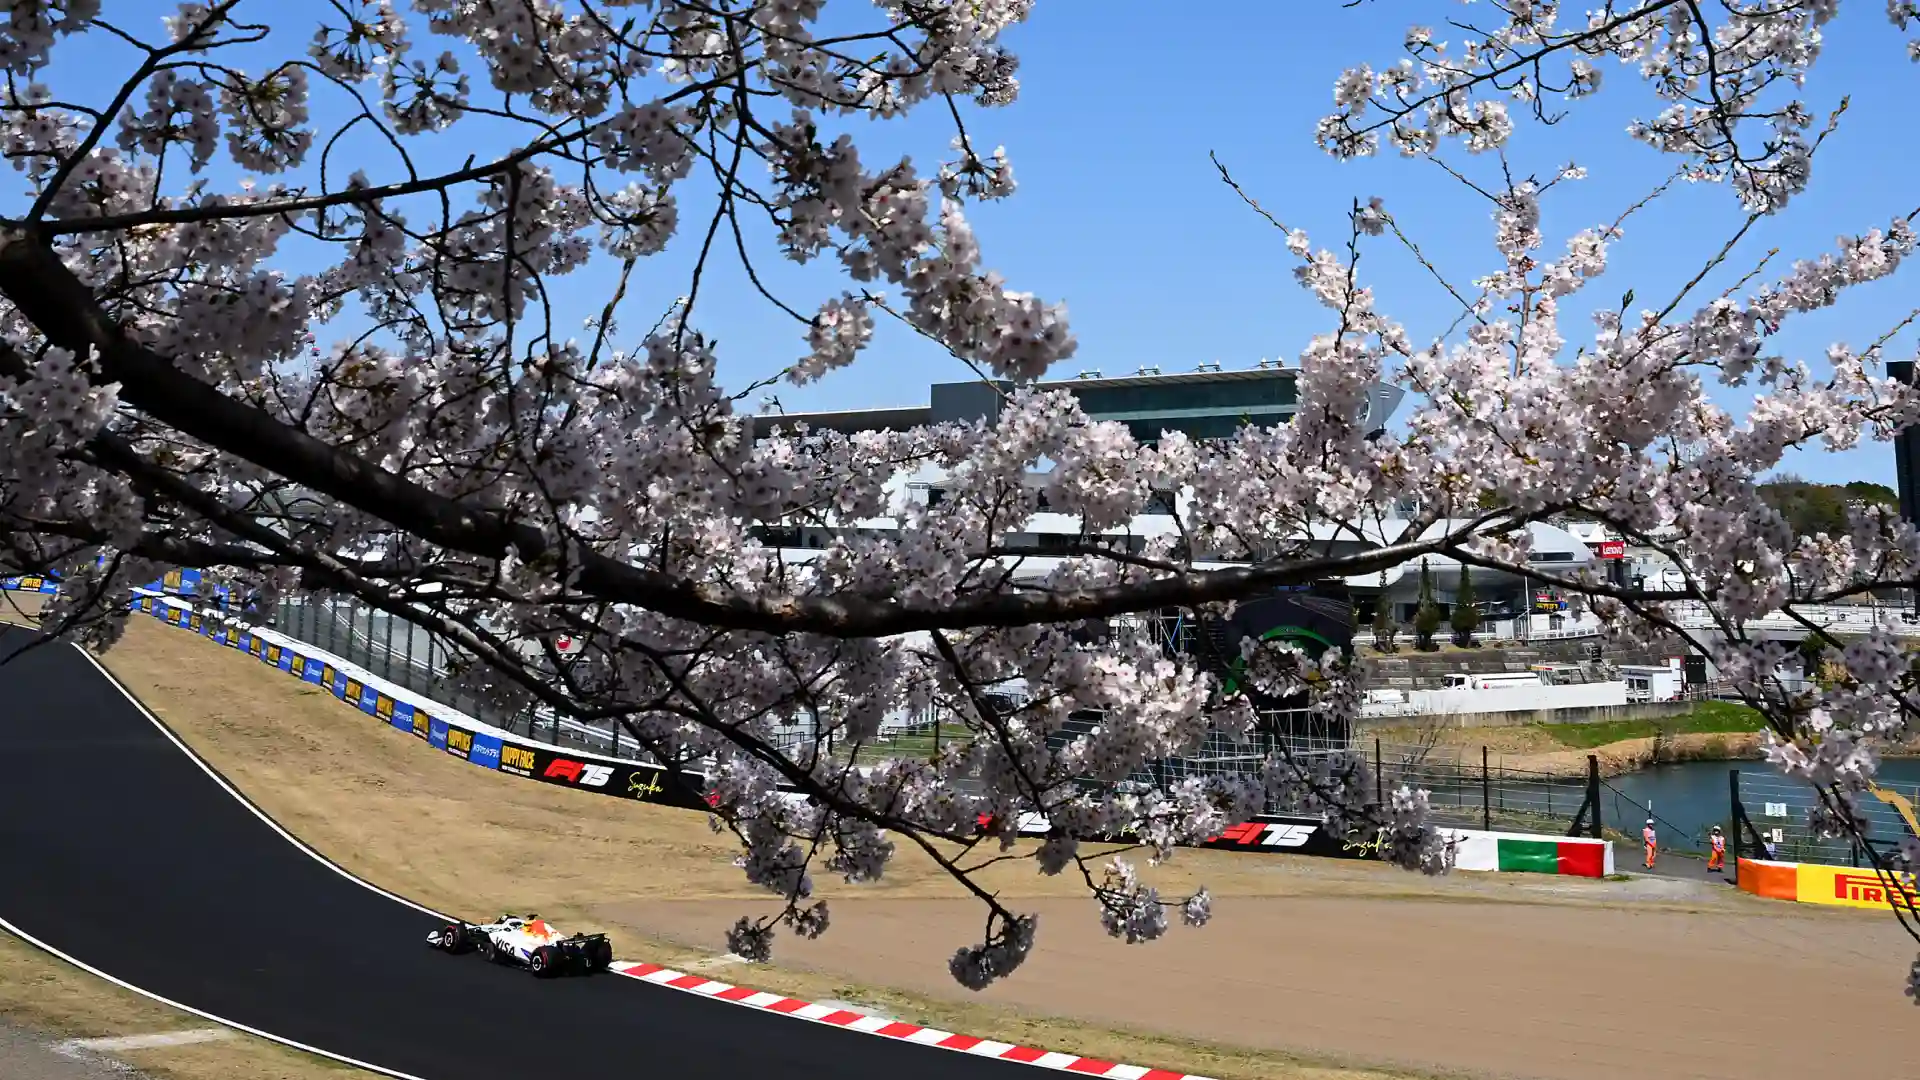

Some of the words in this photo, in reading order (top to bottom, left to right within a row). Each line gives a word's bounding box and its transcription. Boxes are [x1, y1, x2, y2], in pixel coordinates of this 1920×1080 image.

[1603, 544, 1623, 555] Lenovo
[579, 763, 615, 787] 75
[628, 772, 664, 797] Suzuka
[1261, 823, 1318, 847] 75
[495, 936, 515, 957] VISA
